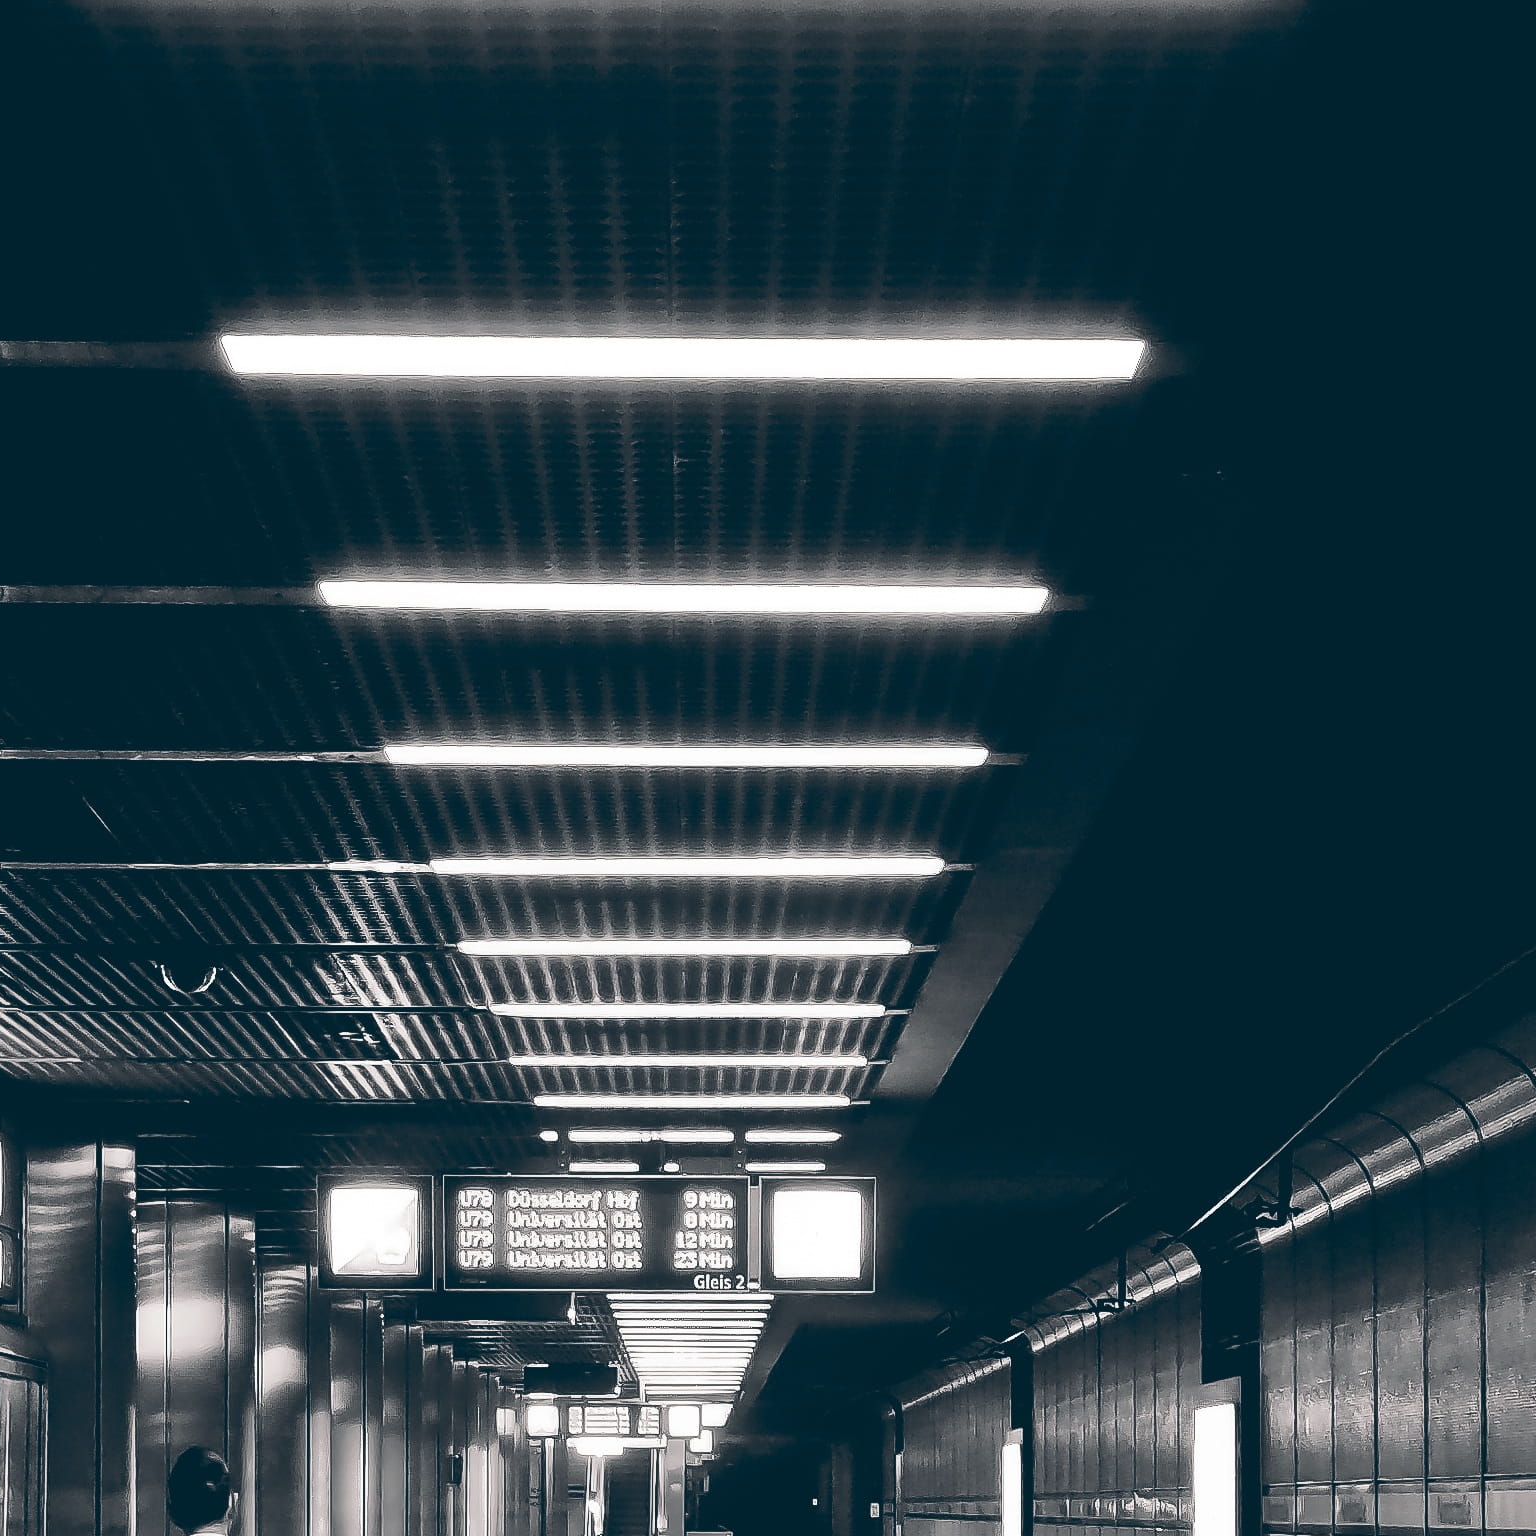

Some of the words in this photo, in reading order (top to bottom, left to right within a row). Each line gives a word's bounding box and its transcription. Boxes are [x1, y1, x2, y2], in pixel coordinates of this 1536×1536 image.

[508, 1190, 602, 1211] Düsseldorf
[607, 1190, 639, 1211] Hbf
[699, 1191, 733, 1209] Min
[508, 1211, 607, 1229] Universität
[612, 1211, 643, 1229] Ost
[699, 1211, 733, 1229] Min
[508, 1231, 607, 1249] Universität
[612, 1231, 643, 1249] Ost
[675, 1230, 698, 1249] 12
[699, 1231, 733, 1249] Min
[508, 1251, 607, 1269] Universität
[612, 1251, 643, 1269] Ost
[699, 1251, 733, 1269] Min
[693, 1274, 732, 1290] Gleis
[735, 1274, 745, 1290] 2
